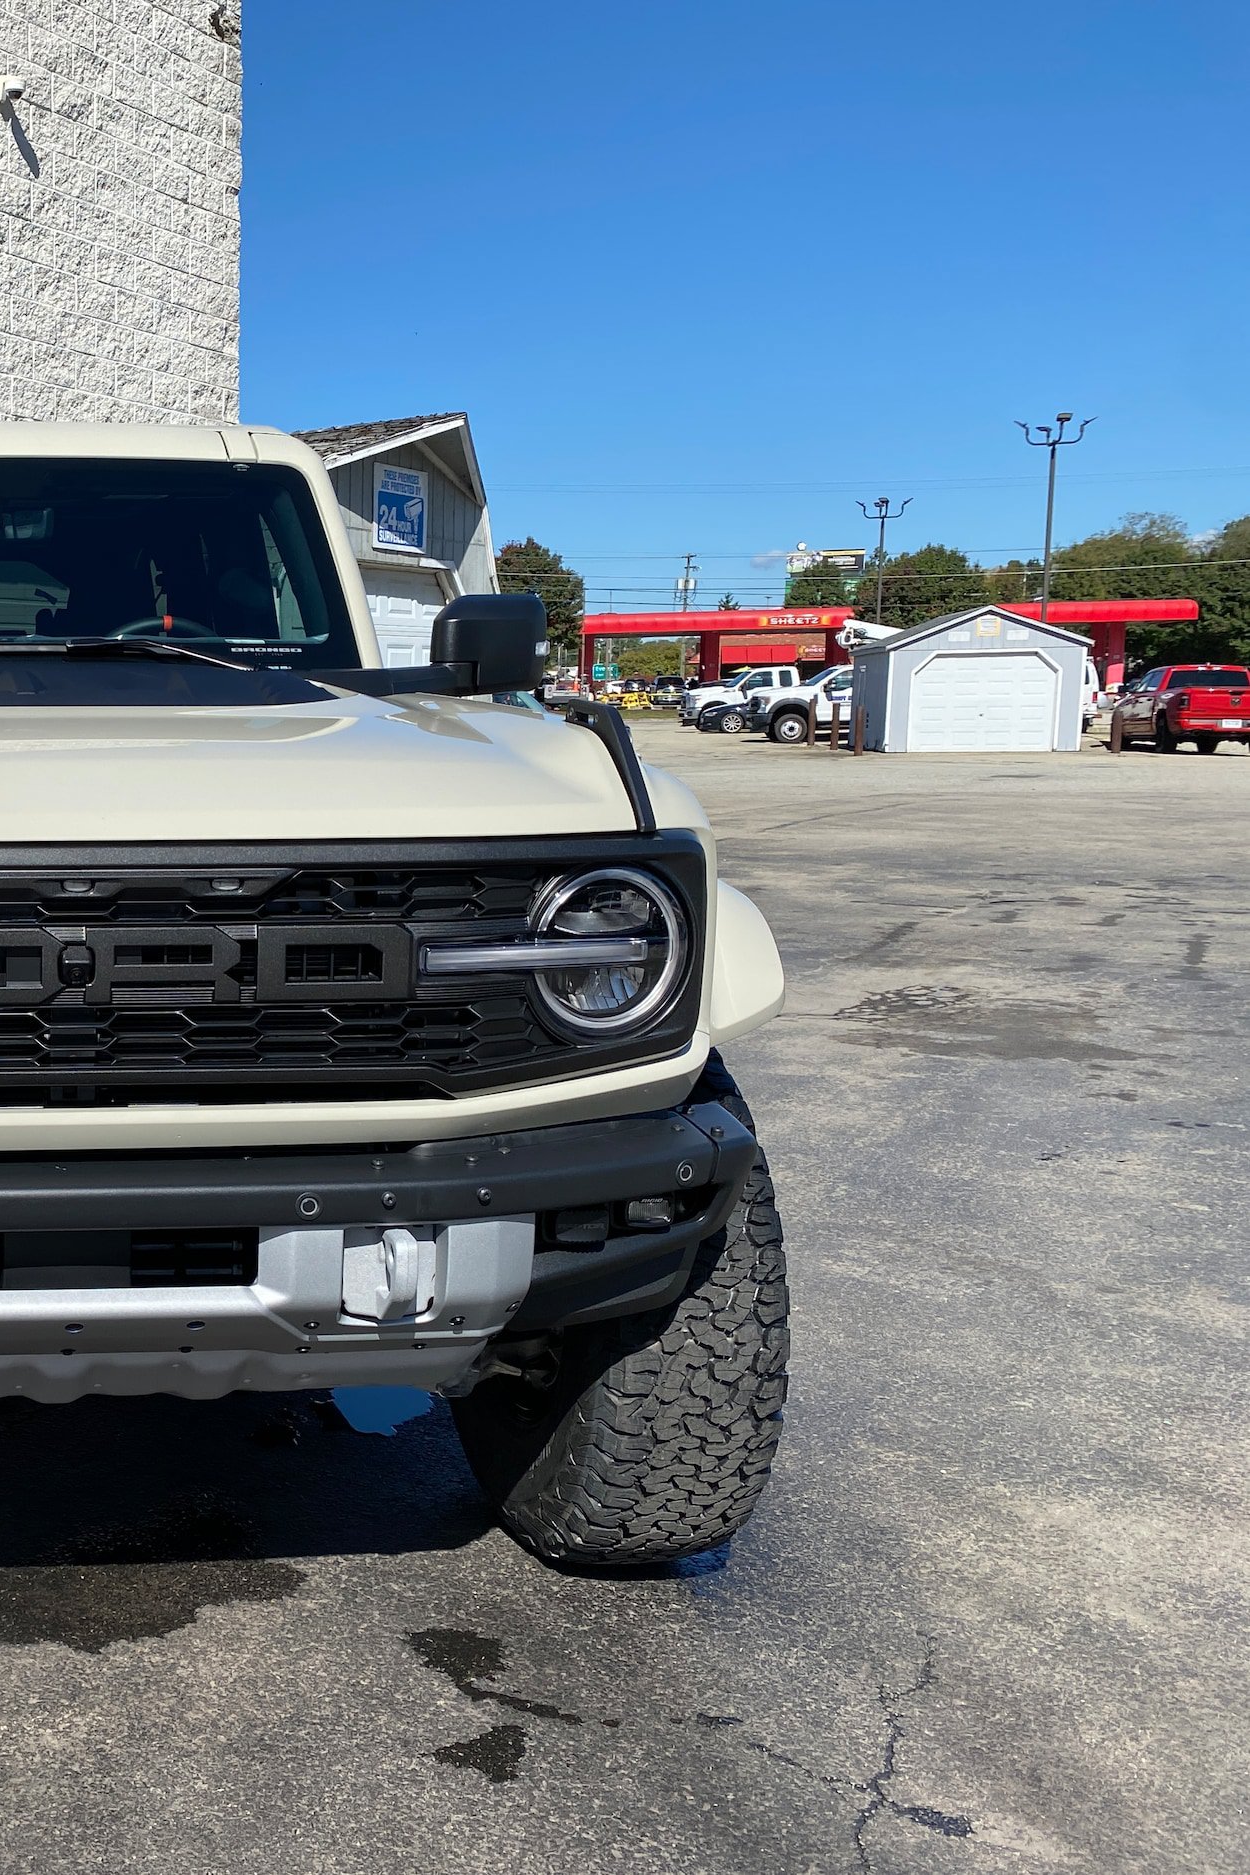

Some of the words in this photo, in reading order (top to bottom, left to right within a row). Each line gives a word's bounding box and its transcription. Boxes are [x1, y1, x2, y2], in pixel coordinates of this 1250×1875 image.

[379, 504, 397, 531] 24
[397, 520, 412, 533] HOUR
[378, 530, 418, 545] SURVEILLANCE
